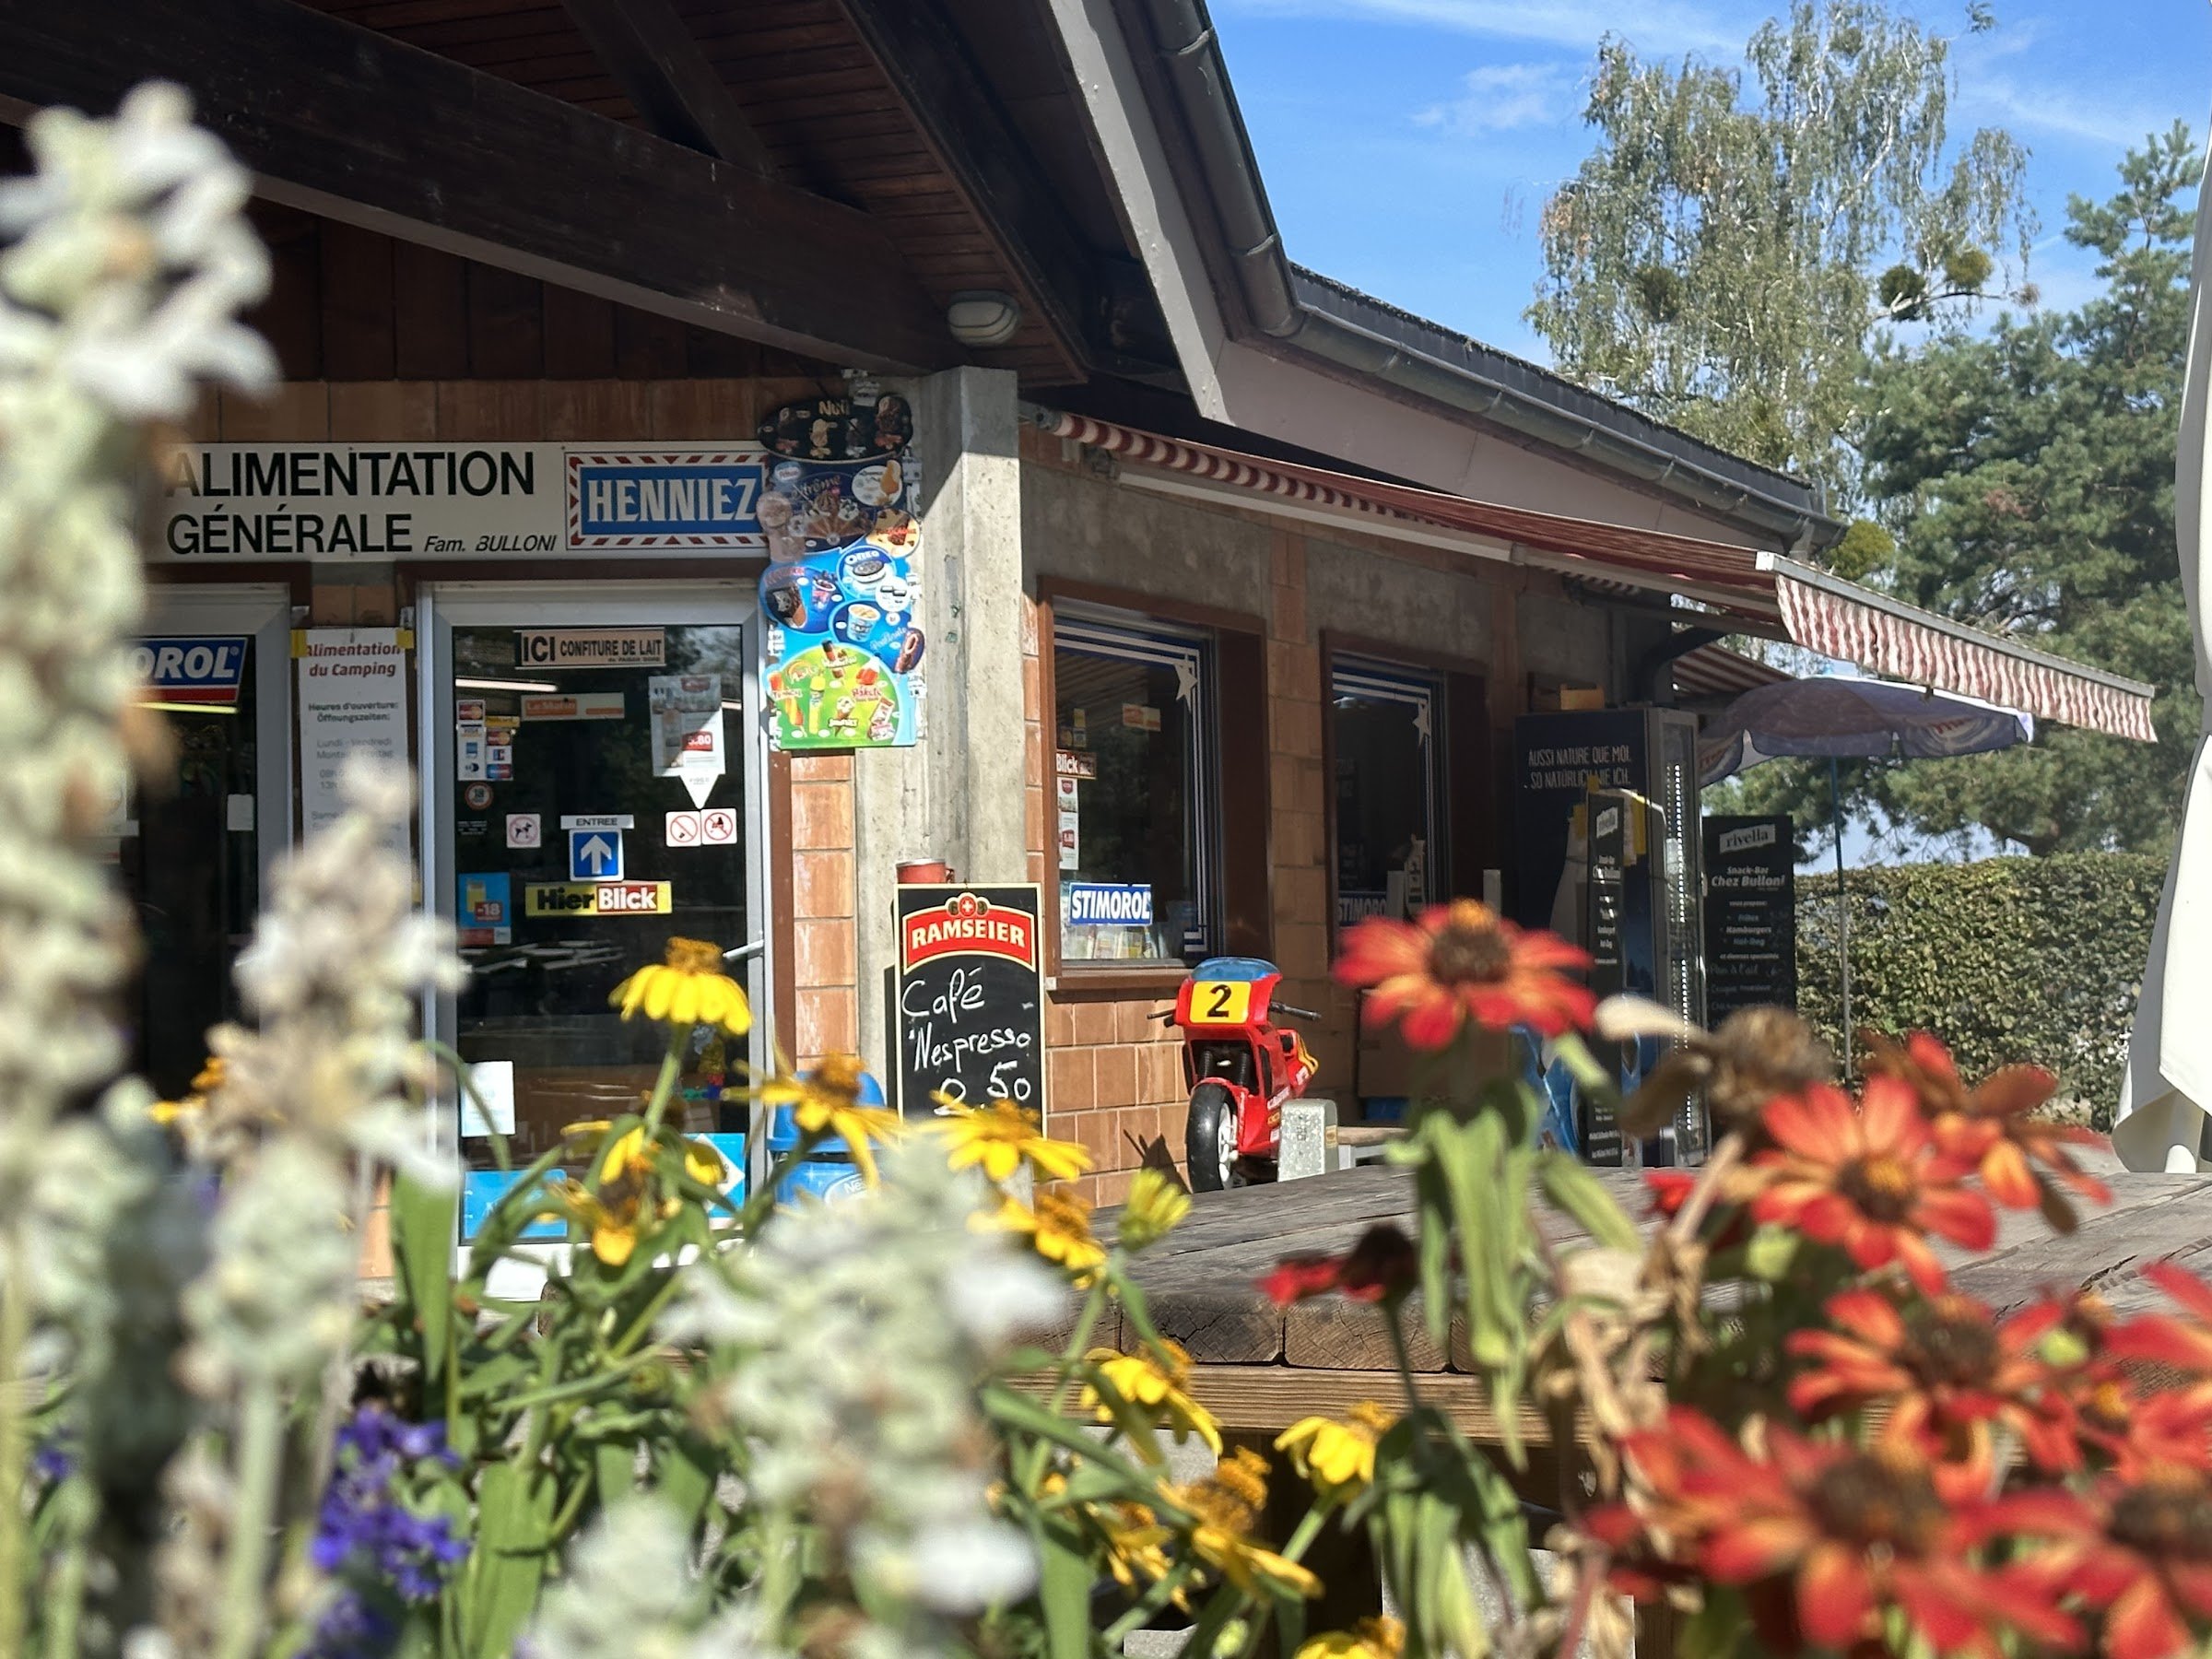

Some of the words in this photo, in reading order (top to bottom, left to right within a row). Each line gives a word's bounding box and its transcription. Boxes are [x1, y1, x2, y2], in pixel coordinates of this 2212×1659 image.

[165, 451, 534, 497] ALIMENTATION
[587, 477, 757, 523] HENNIEZ
[167, 503, 413, 555] GÉNÉRALE
[424, 535, 465, 552] Fam.
[475, 535, 557, 552] BULLONI
[523, 635, 556, 662] ICI
[559, 640, 619, 657] CONFITURE
[622, 640, 637, 656] DE
[640, 639, 662, 655] LAIT
[131, 646, 235, 678] OROL
[309, 664, 328, 677] du
[332, 662, 396, 677] Camping
[1055, 753, 1079, 774] Blick
[1529, 748, 1555, 767] AUSSI
[1557, 747, 1589, 765] NATURE
[1592, 745, 1610, 764] QUE
[1612, 744, 1631, 763] MOI.
[1530, 771, 1542, 789] SO
[1612, 767, 1631, 784] ICH.
[575, 817, 618, 827] ENTREE
[1726, 829, 1769, 847] rivella
[1712, 875, 1739, 887] Chez
[1741, 875, 1785, 887] Bulloni
[1727, 865, 1769, 875] Snack-Bar
[536, 887, 595, 911] Hier
[598, 886, 657, 911] Blick
[1071, 889, 1151, 920] STIMOROL
[1338, 897, 1386, 923] STIMORO
[912, 919, 1025, 950] RAMSEIER
[900, 967, 985, 1023] Café
[1206, 984, 1232, 1018] 2
[912, 1021, 1031, 1073] Nespresso
